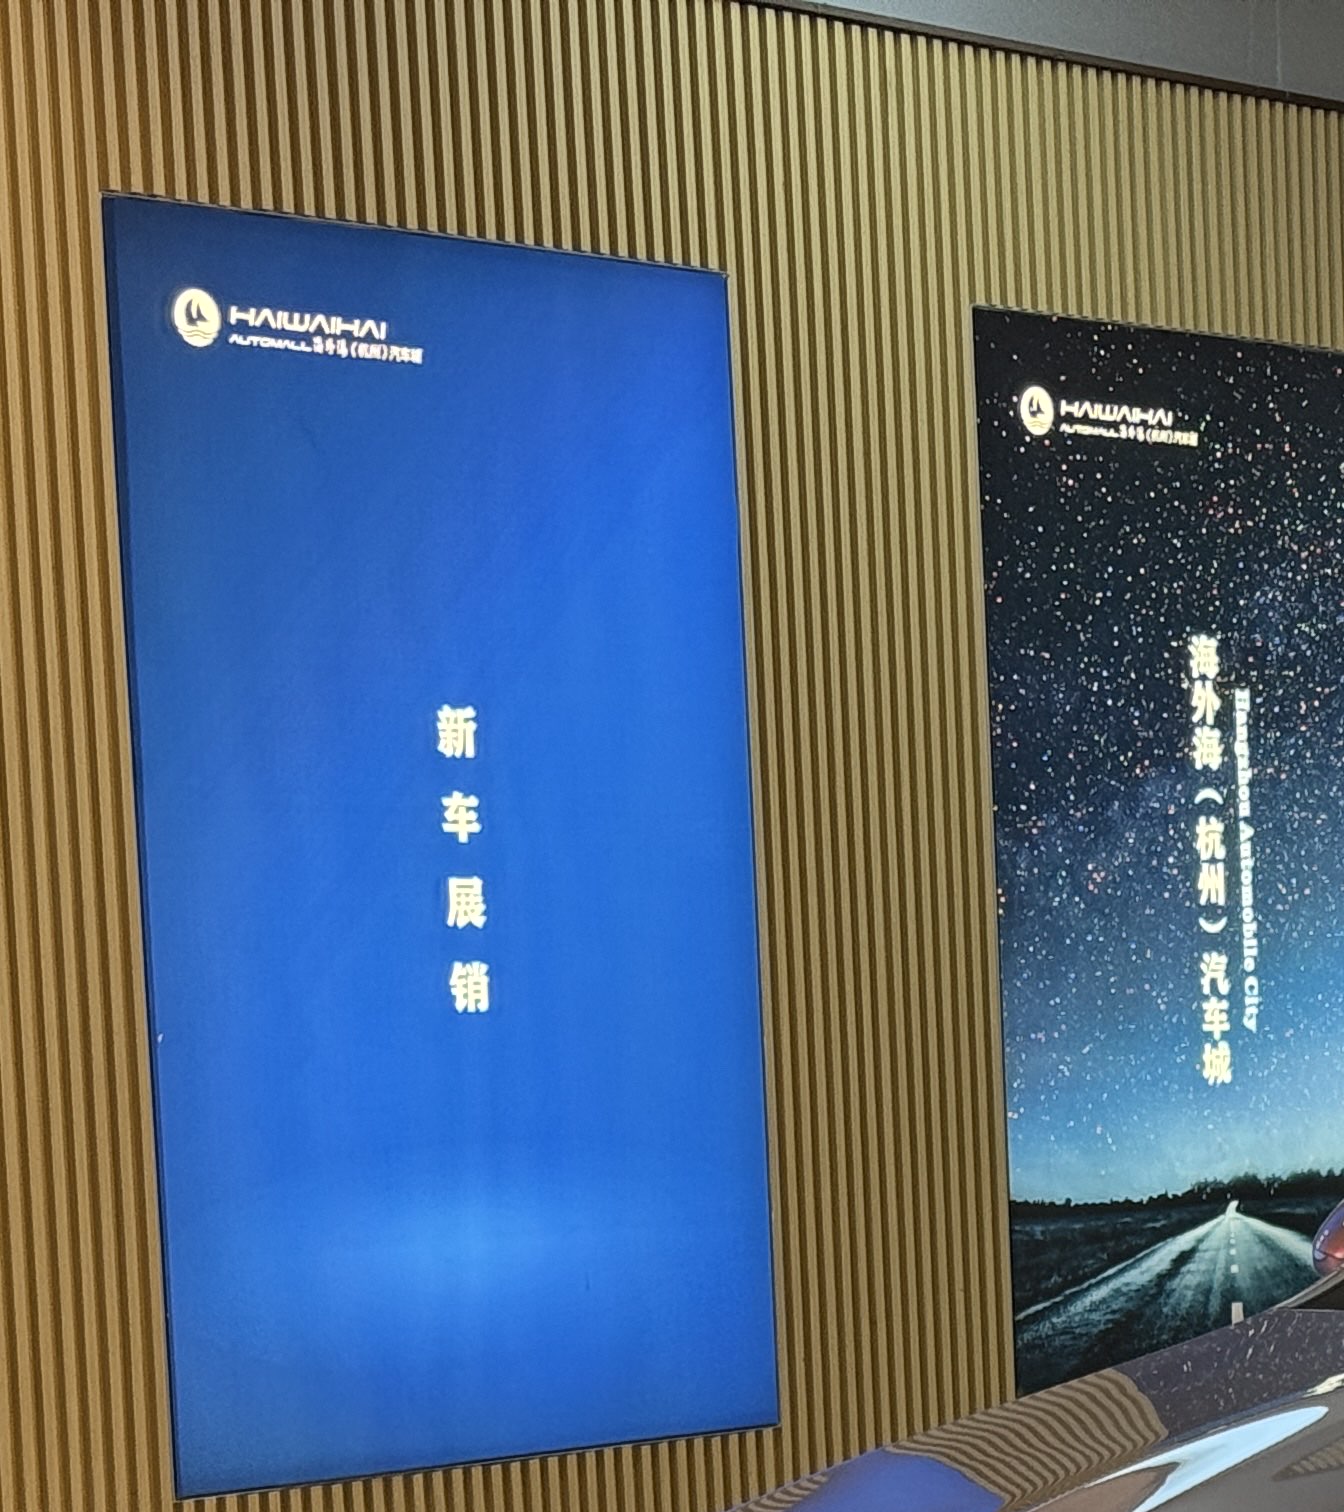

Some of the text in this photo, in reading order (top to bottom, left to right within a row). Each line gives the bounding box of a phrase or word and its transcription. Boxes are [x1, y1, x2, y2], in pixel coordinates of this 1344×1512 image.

[228, 305, 387, 340] HAIWAIHAI
[436, 704, 490, 1014] 新车展销
